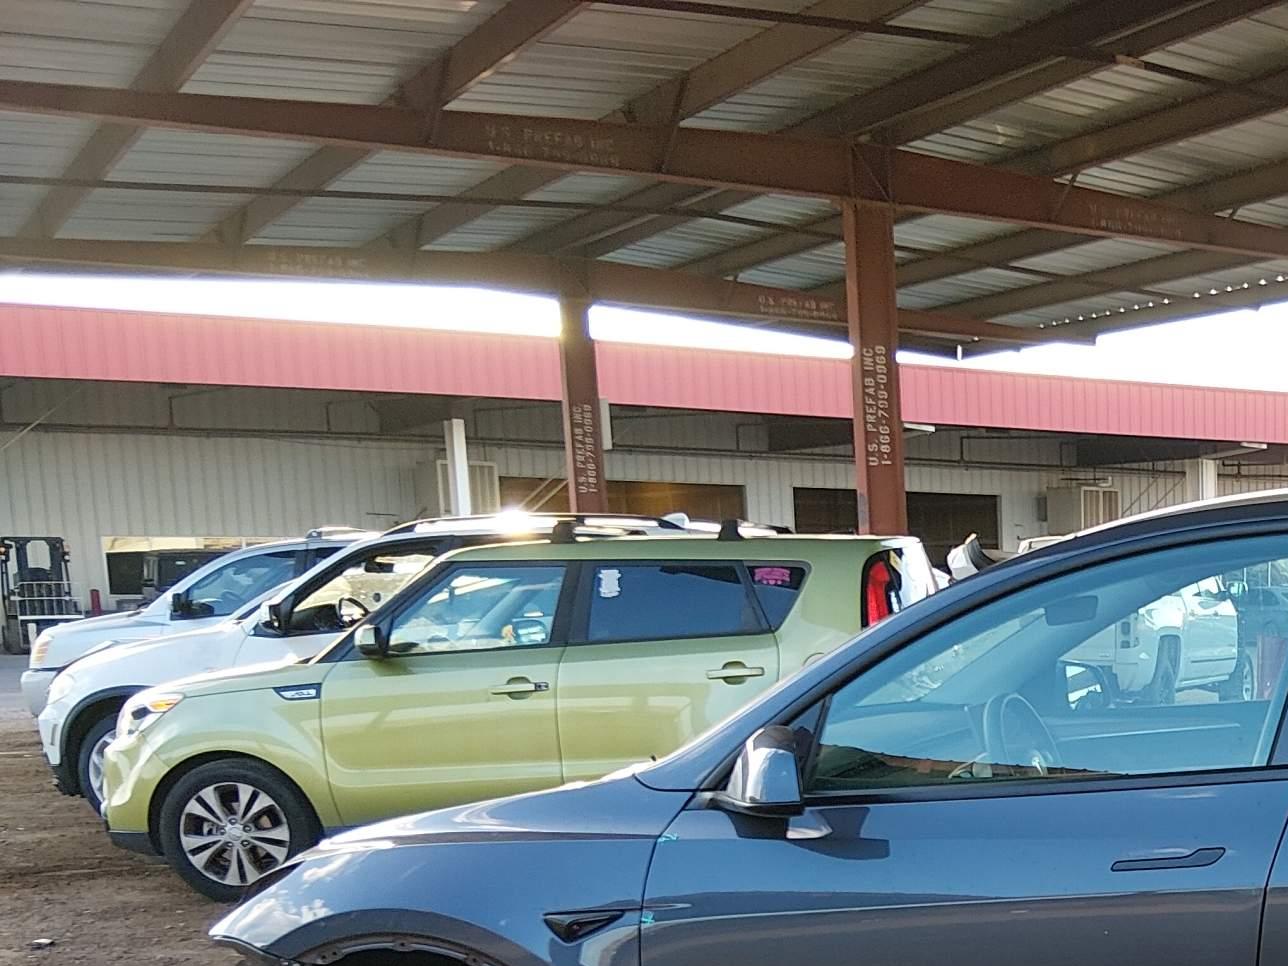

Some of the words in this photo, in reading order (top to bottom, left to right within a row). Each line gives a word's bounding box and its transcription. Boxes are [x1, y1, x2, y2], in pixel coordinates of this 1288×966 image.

[863, 347, 874, 371] INC
[864, 378, 877, 432] PREFAB
[875, 345, 892, 465] 1-866-799-0969
[868, 440, 880, 466] U.S.
